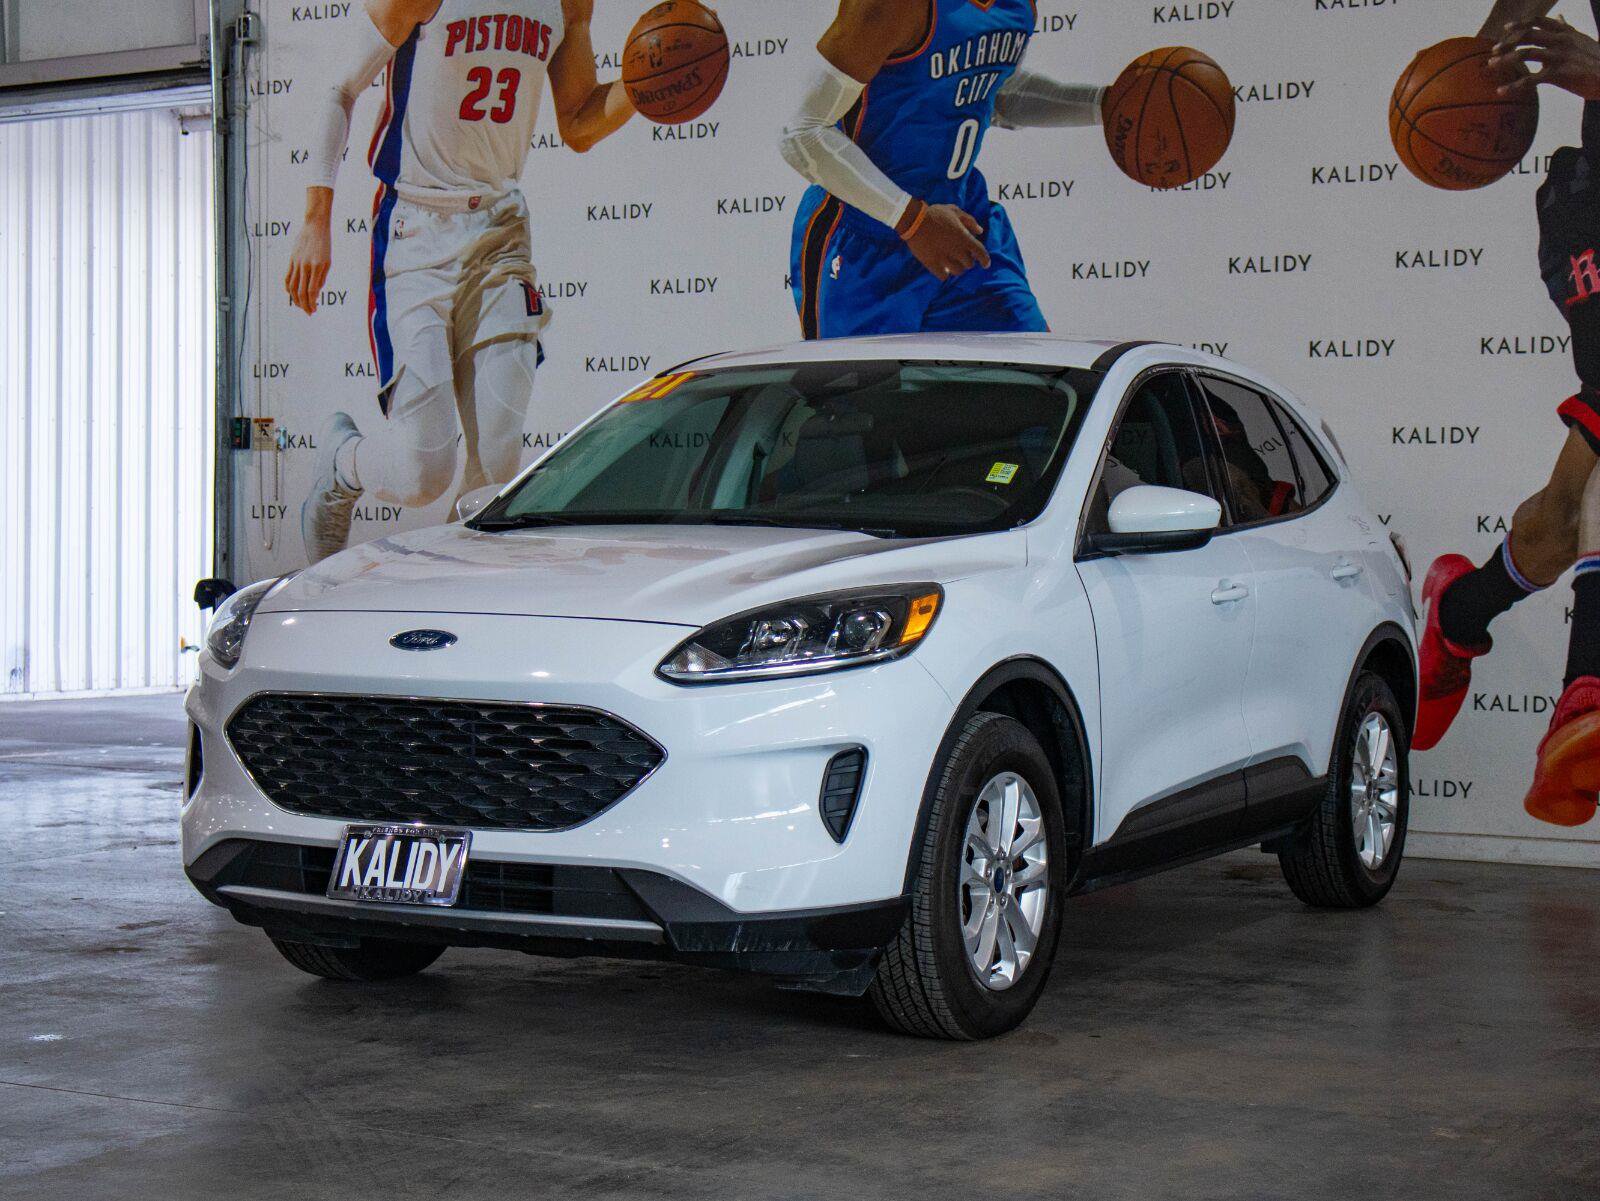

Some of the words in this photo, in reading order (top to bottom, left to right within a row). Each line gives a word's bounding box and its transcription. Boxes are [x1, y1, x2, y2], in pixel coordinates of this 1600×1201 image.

[292, 3, 350, 21] KALIDY
[1153, 1, 1235, 24] KALIDY
[445, 14, 552, 63] PISTONS
[732, 38, 788, 58] ALIDY
[459, 66, 521, 124] 23
[955, 73, 999, 107] CITY
[1234, 80, 1315, 103] KALIDY
[653, 122, 720, 141] KALIDY
[1312, 163, 1398, 184] KALIDY
[998, 181, 1075, 200] KALIDY
[587, 203, 653, 221] KALIDY
[717, 196, 787, 215] KALIDY
[1229, 254, 1312, 275] KALIDY
[1396, 248, 1484, 269] KALIDY
[1072, 260, 1151, 280] KALIDY
[538, 282, 588, 298] ALIDY
[650, 277, 719, 295] KALIDY
[1309, 339, 1396, 358] KALIDY
[1481, 335, 1571, 355] KALIDY
[585, 356, 651, 372] KALIDY
[1393, 426, 1480, 445] KALIDY
[353, 506, 402, 522] ALIDY
[341, 838, 461, 893] KALIDY
